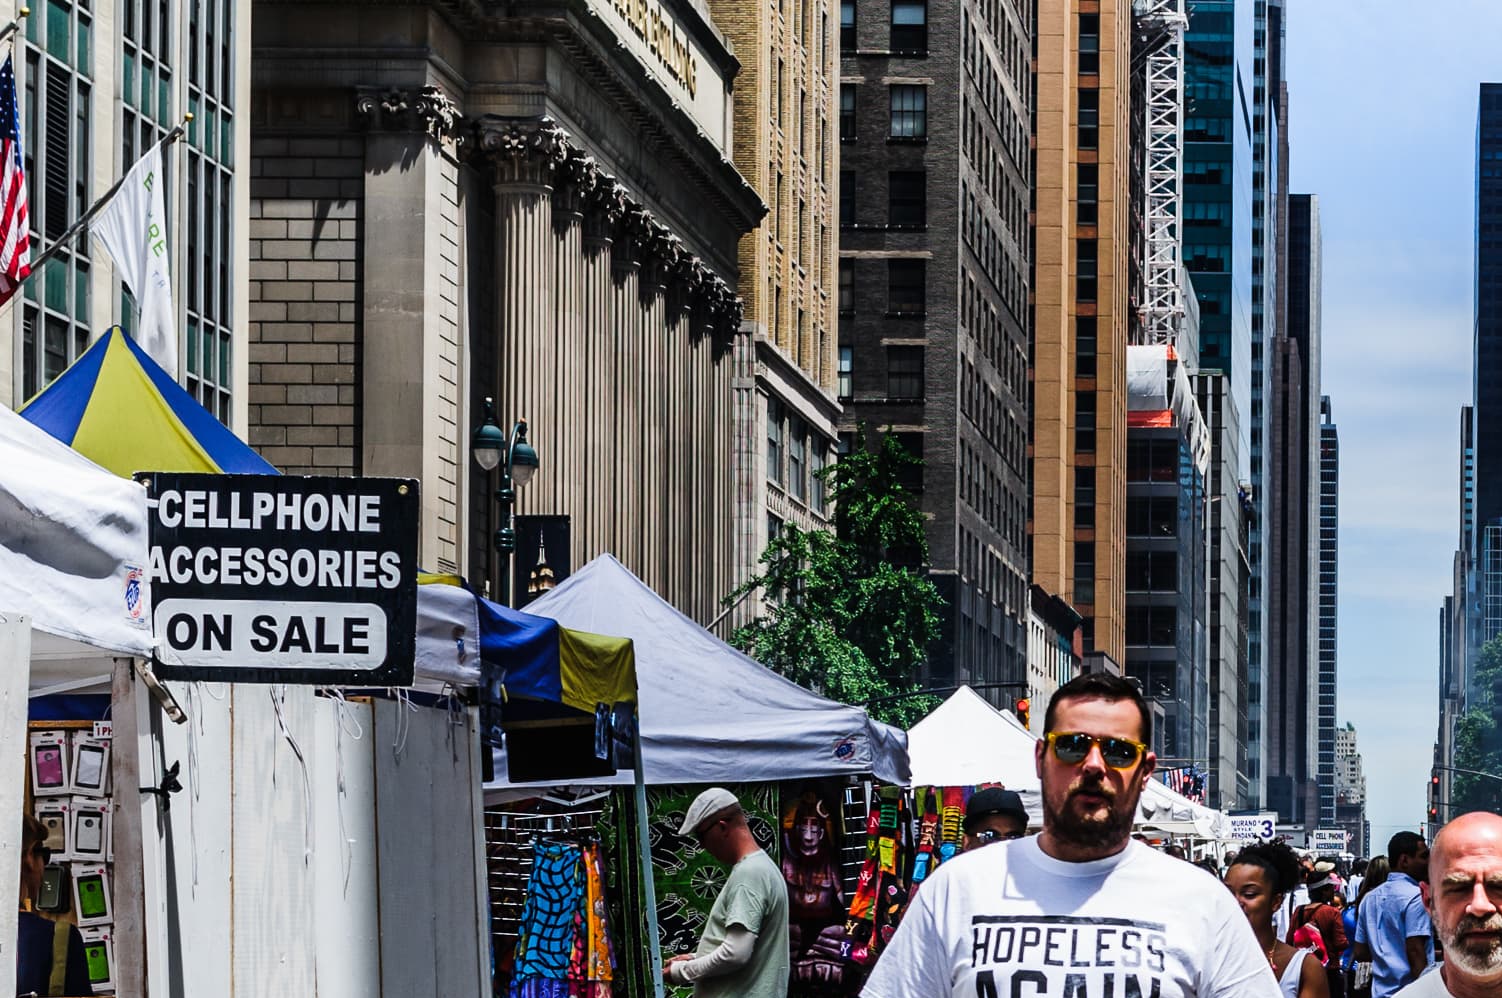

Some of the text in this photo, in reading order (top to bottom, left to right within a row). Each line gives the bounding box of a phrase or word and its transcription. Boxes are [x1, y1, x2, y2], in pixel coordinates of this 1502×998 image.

[158, 489, 382, 533] CELLPHONE
[150, 545, 402, 590] ACCESSORIES
[166, 612, 370, 655] ON SALE
[1328, 832, 1344, 840] PHONE
[972, 927, 1167, 973] HOPELESS
